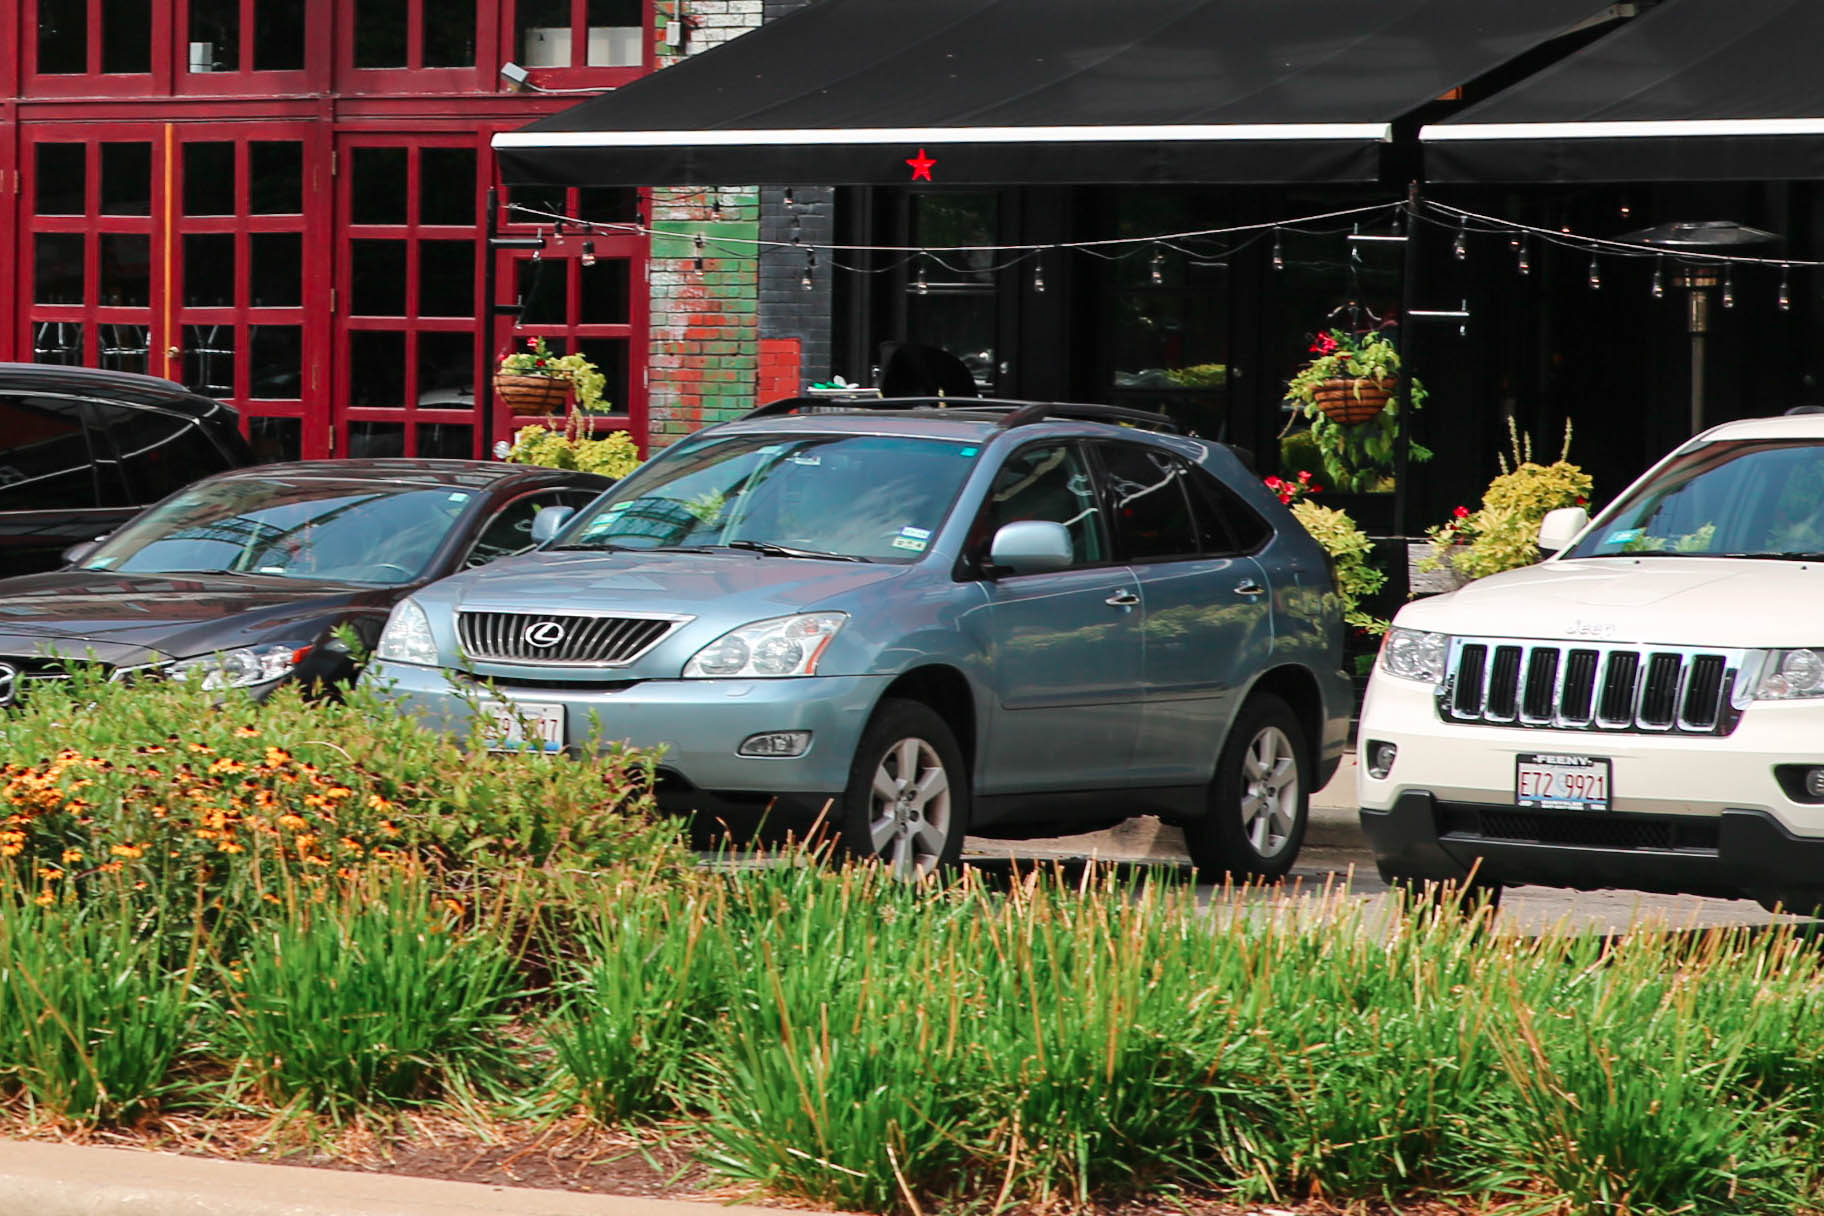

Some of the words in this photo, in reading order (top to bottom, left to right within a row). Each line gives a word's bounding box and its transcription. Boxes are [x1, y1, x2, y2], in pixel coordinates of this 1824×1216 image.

[1536, 755, 1587, 765] FEENY
[1520, 772, 1553, 798] E72
[1565, 774, 1606, 801] 9921
